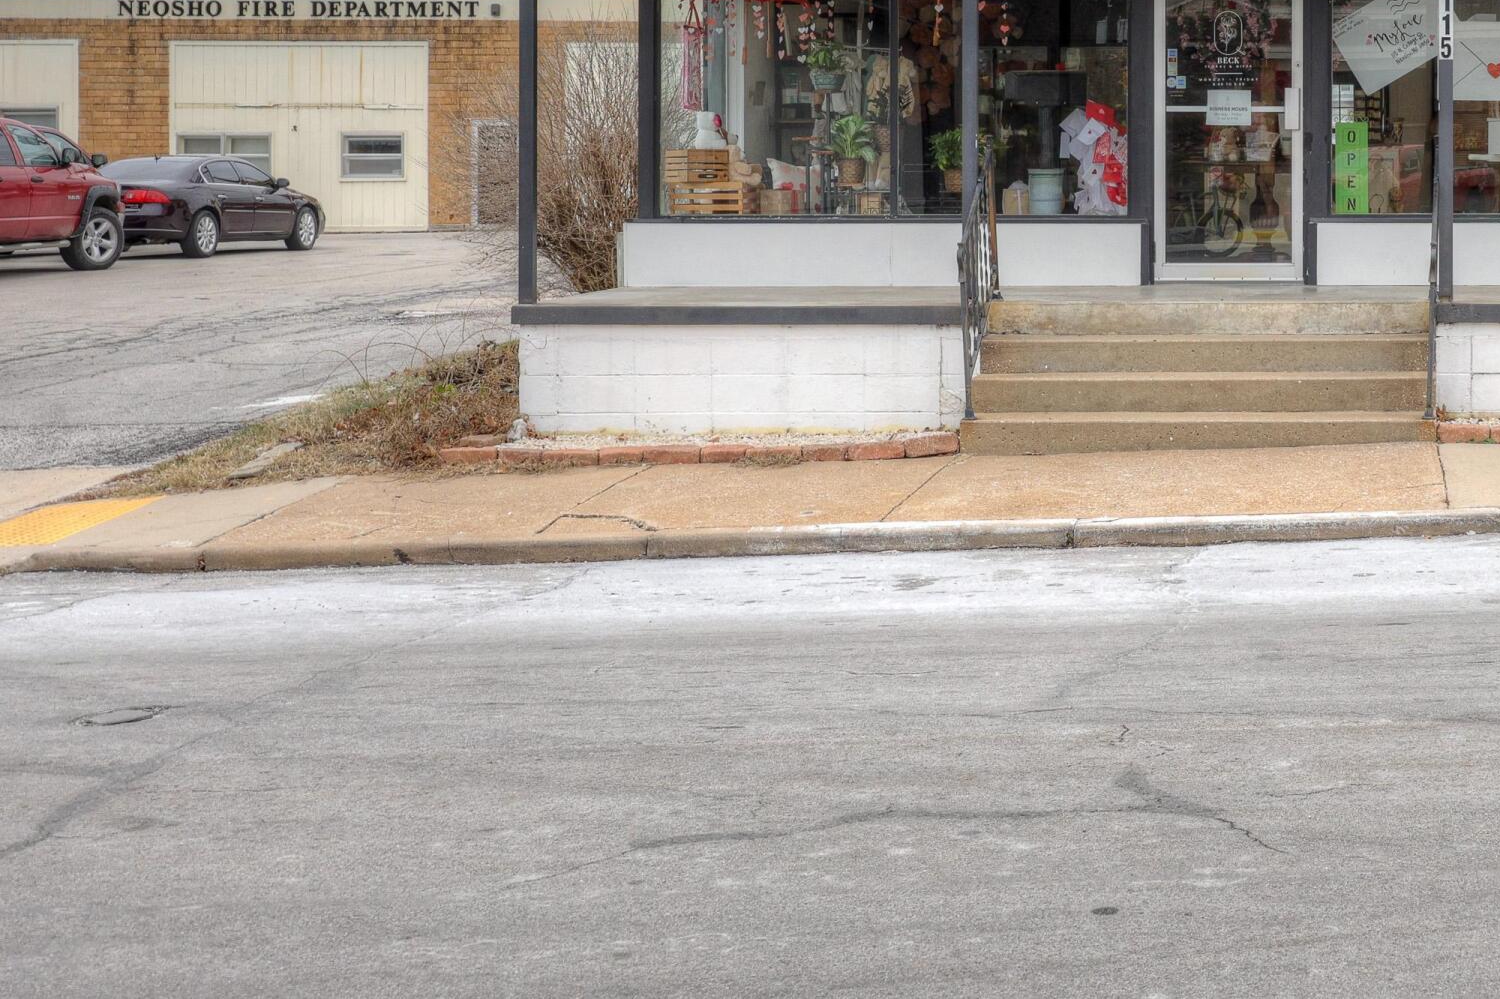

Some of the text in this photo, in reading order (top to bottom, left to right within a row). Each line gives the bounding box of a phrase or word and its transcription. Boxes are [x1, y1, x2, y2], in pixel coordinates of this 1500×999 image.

[117, 0, 480, 18] NEOSHO FIRE DEPARTMENT
[1217, 56, 1240, 64] BECK
[1347, 130, 1357, 211] OPEN
